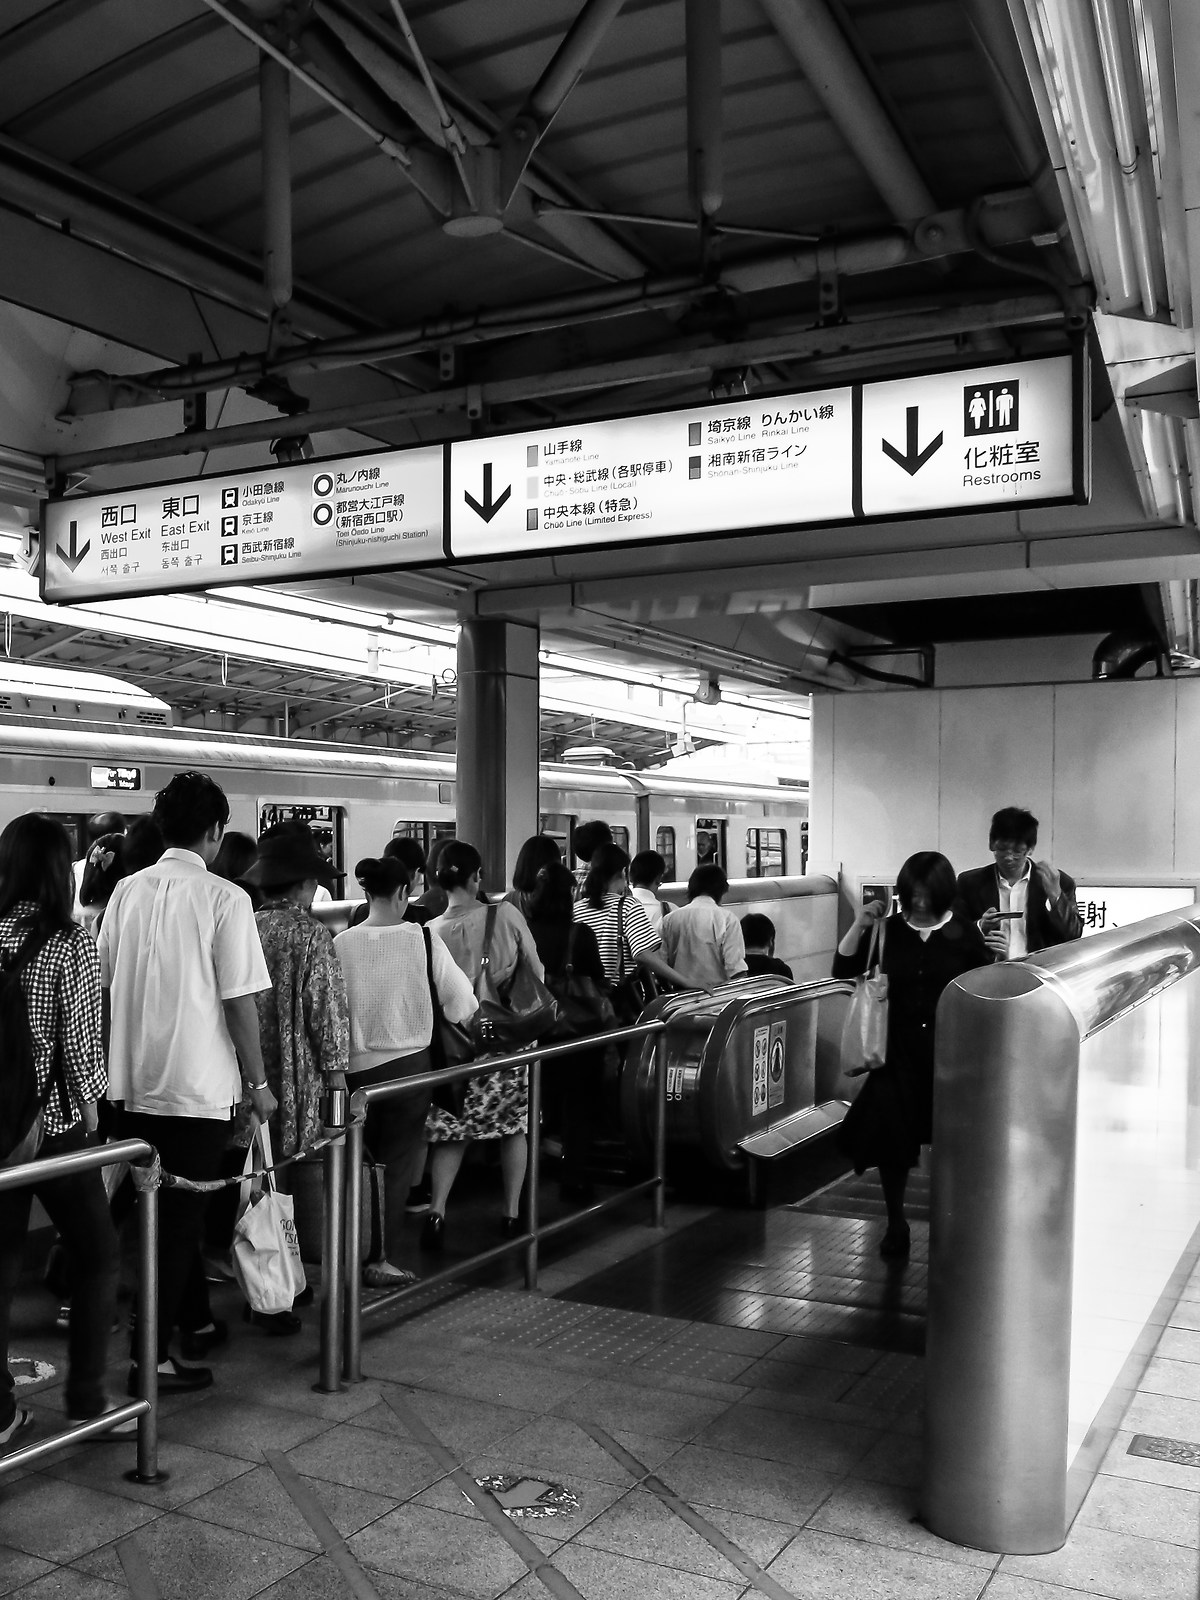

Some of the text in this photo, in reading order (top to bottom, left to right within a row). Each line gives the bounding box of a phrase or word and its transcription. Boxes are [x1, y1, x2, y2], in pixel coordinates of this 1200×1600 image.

[707, 404, 834, 434] 埼京線 りんかい線
[738, 432, 756, 441] Line
[761, 428, 789, 438] Rinkai
[791, 425, 810, 434] Line
[544, 439, 583, 456] 山手線
[707, 444, 808, 468] 湘南新宿ライン
[963, 440, 1041, 470] 化粧室
[544, 453, 600, 466] Yamanote Line
[780, 461, 799, 471] Line
[336, 467, 381, 484] 丸ノ内線
[963, 469, 1042, 487] Restrooms
[242, 480, 285, 498] 小田急線
[336, 481, 390, 494] Marunouchi Line
[591, 482, 608, 492] Line
[610, 480, 637, 491] (Local)
[161, 494, 200, 519] 東口
[266, 495, 280, 503] Line
[336, 493, 405, 514] 都営大江戸線
[543, 496, 639, 519] 中央本線(特急)
[101, 504, 137, 528] 西口
[242, 511, 274, 526] 京王線
[335, 509, 404, 529] (新宿西口駅)
[566, 518, 583, 527] Line
[584, 515, 616, 526] (Limited
[617, 511, 653, 523] Express)
[100, 527, 151, 545] West Exit
[161, 520, 210, 537] East Exit
[336, 530, 350, 538] Toei
[370, 526, 385, 534] Line
[161, 539, 190, 552] 东出口
[242, 537, 295, 554] 西武新宿線
[335, 529, 429, 548] (Shinjuku-nishiguchi Station)
[100, 547, 128, 560] 西出口
[241, 552, 287, 564] Seibu-Shinjuku
